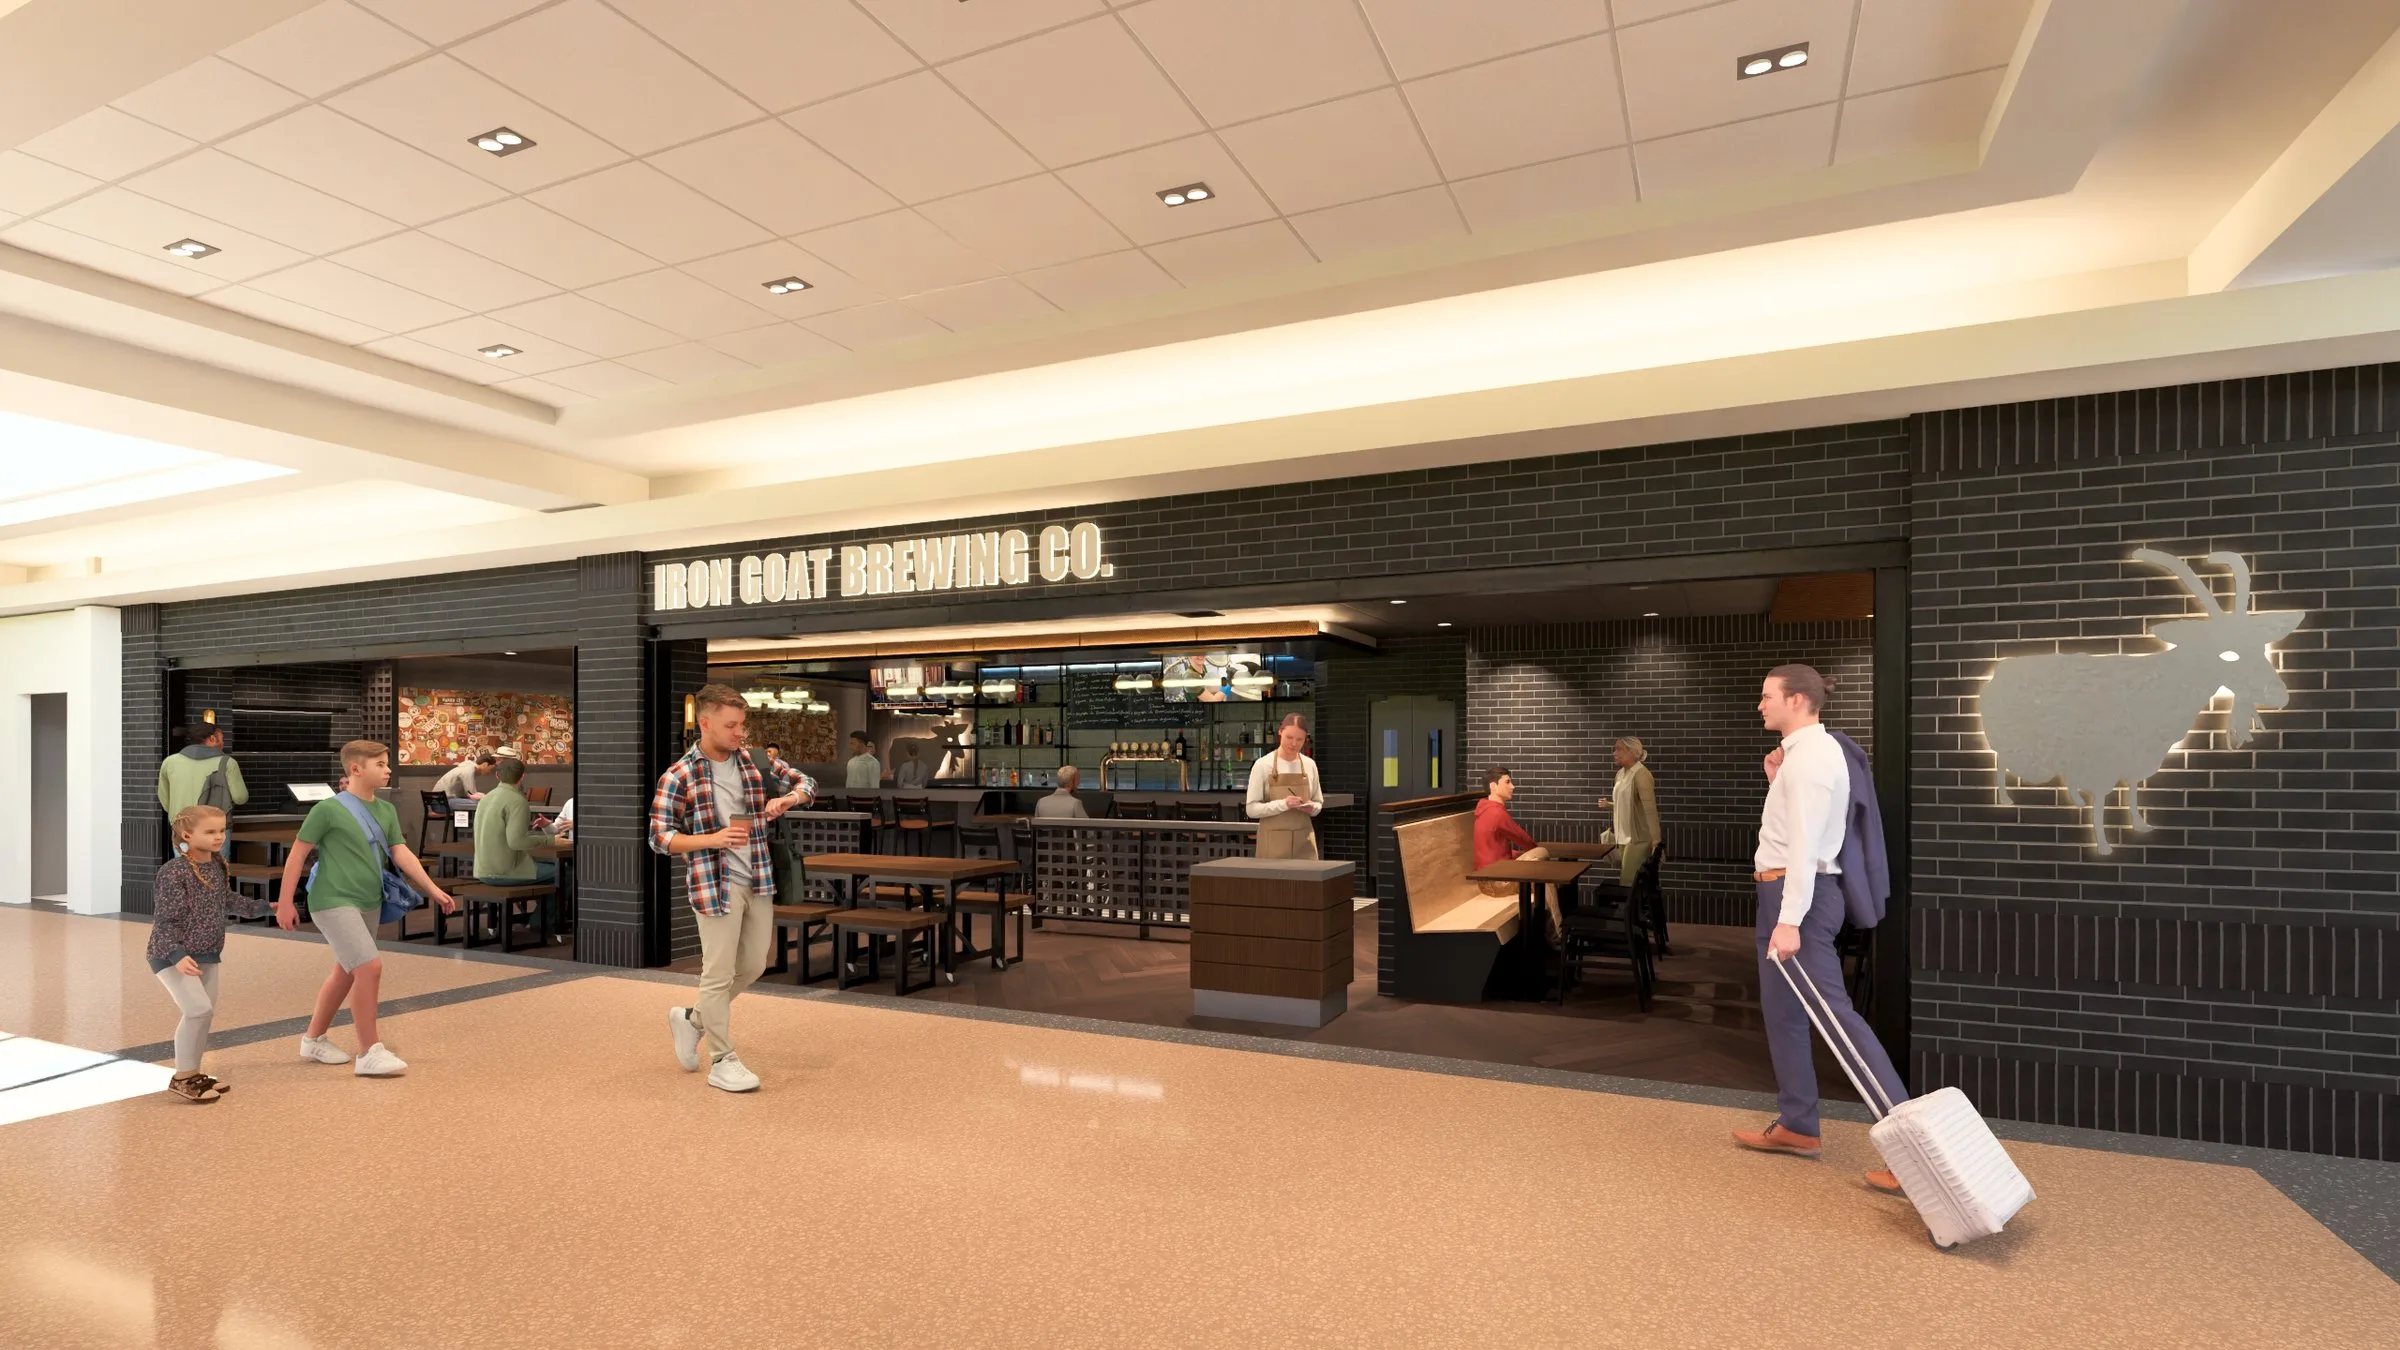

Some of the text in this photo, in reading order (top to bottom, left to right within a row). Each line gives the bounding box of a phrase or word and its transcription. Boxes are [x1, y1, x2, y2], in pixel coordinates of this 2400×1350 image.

[654, 522, 1114, 611] IRON GOAT BREWING CO.
